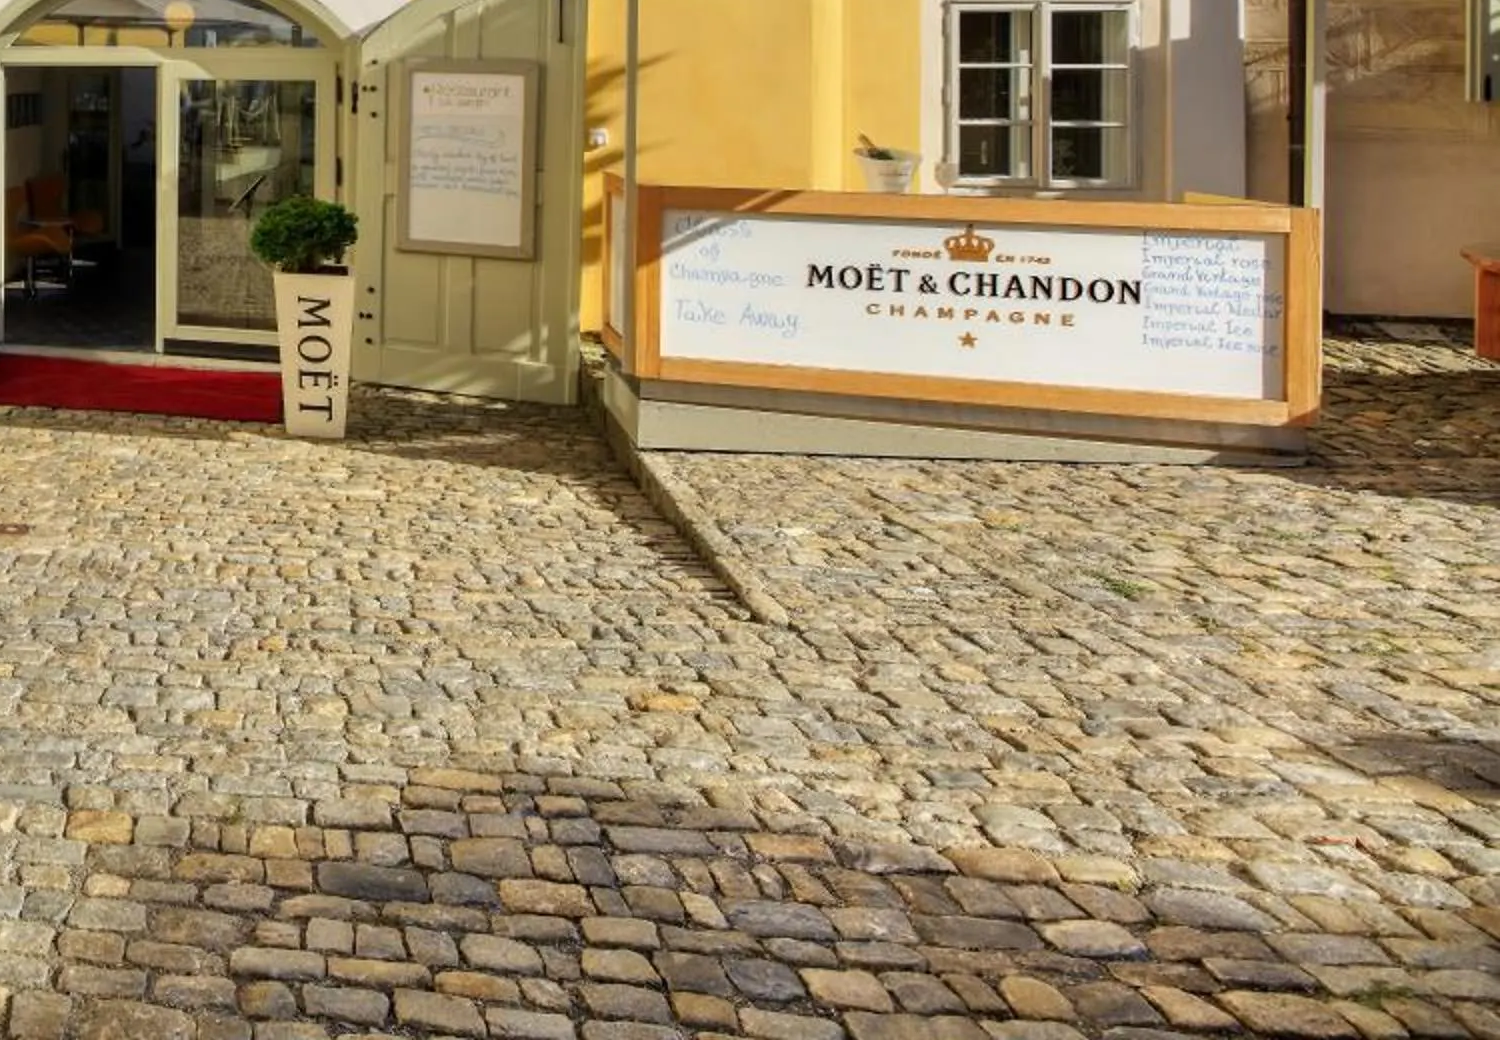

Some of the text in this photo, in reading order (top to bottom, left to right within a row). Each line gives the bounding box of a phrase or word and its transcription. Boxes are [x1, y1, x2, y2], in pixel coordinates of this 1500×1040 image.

[807, 263, 1142, 306] MOËT & CHANDON
[865, 302, 1076, 328] CHAMPAGNE
[297, 295, 340, 422] MOËT
